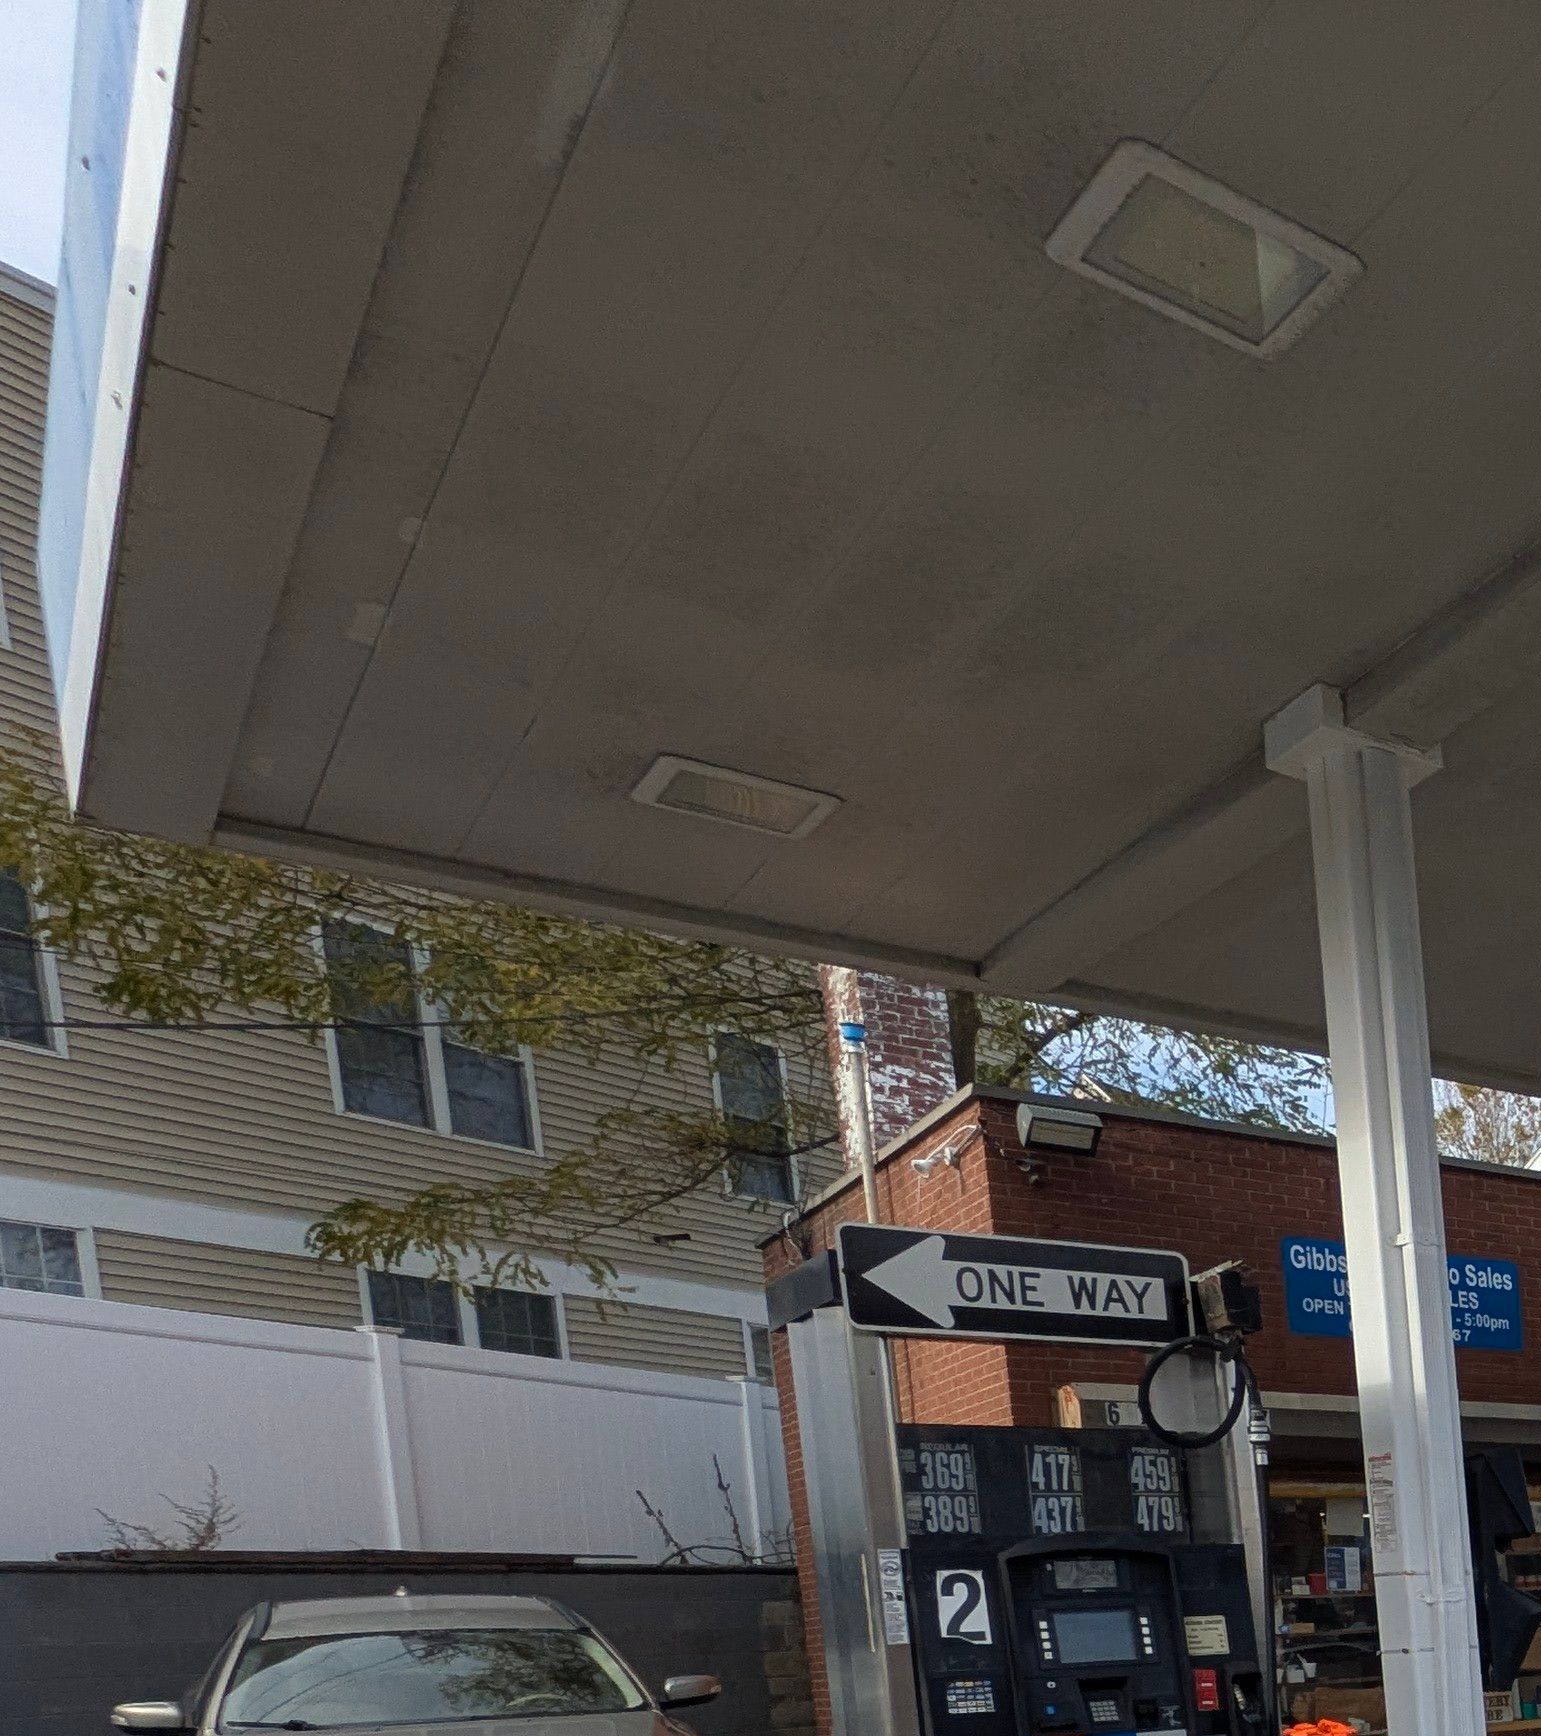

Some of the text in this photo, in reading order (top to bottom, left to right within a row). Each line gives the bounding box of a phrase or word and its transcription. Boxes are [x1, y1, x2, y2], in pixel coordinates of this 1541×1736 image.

[1290, 1244, 1347, 1273] Gibbs
[1466, 1264, 1512, 1291] Sales
[955, 1266, 1152, 1315] ONE WAY
[1302, 1297, 1344, 1315] OPEN
[1464, 1313, 1510, 1330] 5:00pm
[920, 1451, 965, 1491] 369
[1031, 1453, 1071, 1492] 417
[1130, 1455, 1172, 1493] 459
[924, 1495, 970, 1534] 389
[1033, 1497, 1074, 1534] 437
[1136, 1496, 1176, 1532] 479
[940, 1572, 987, 1642] 2
